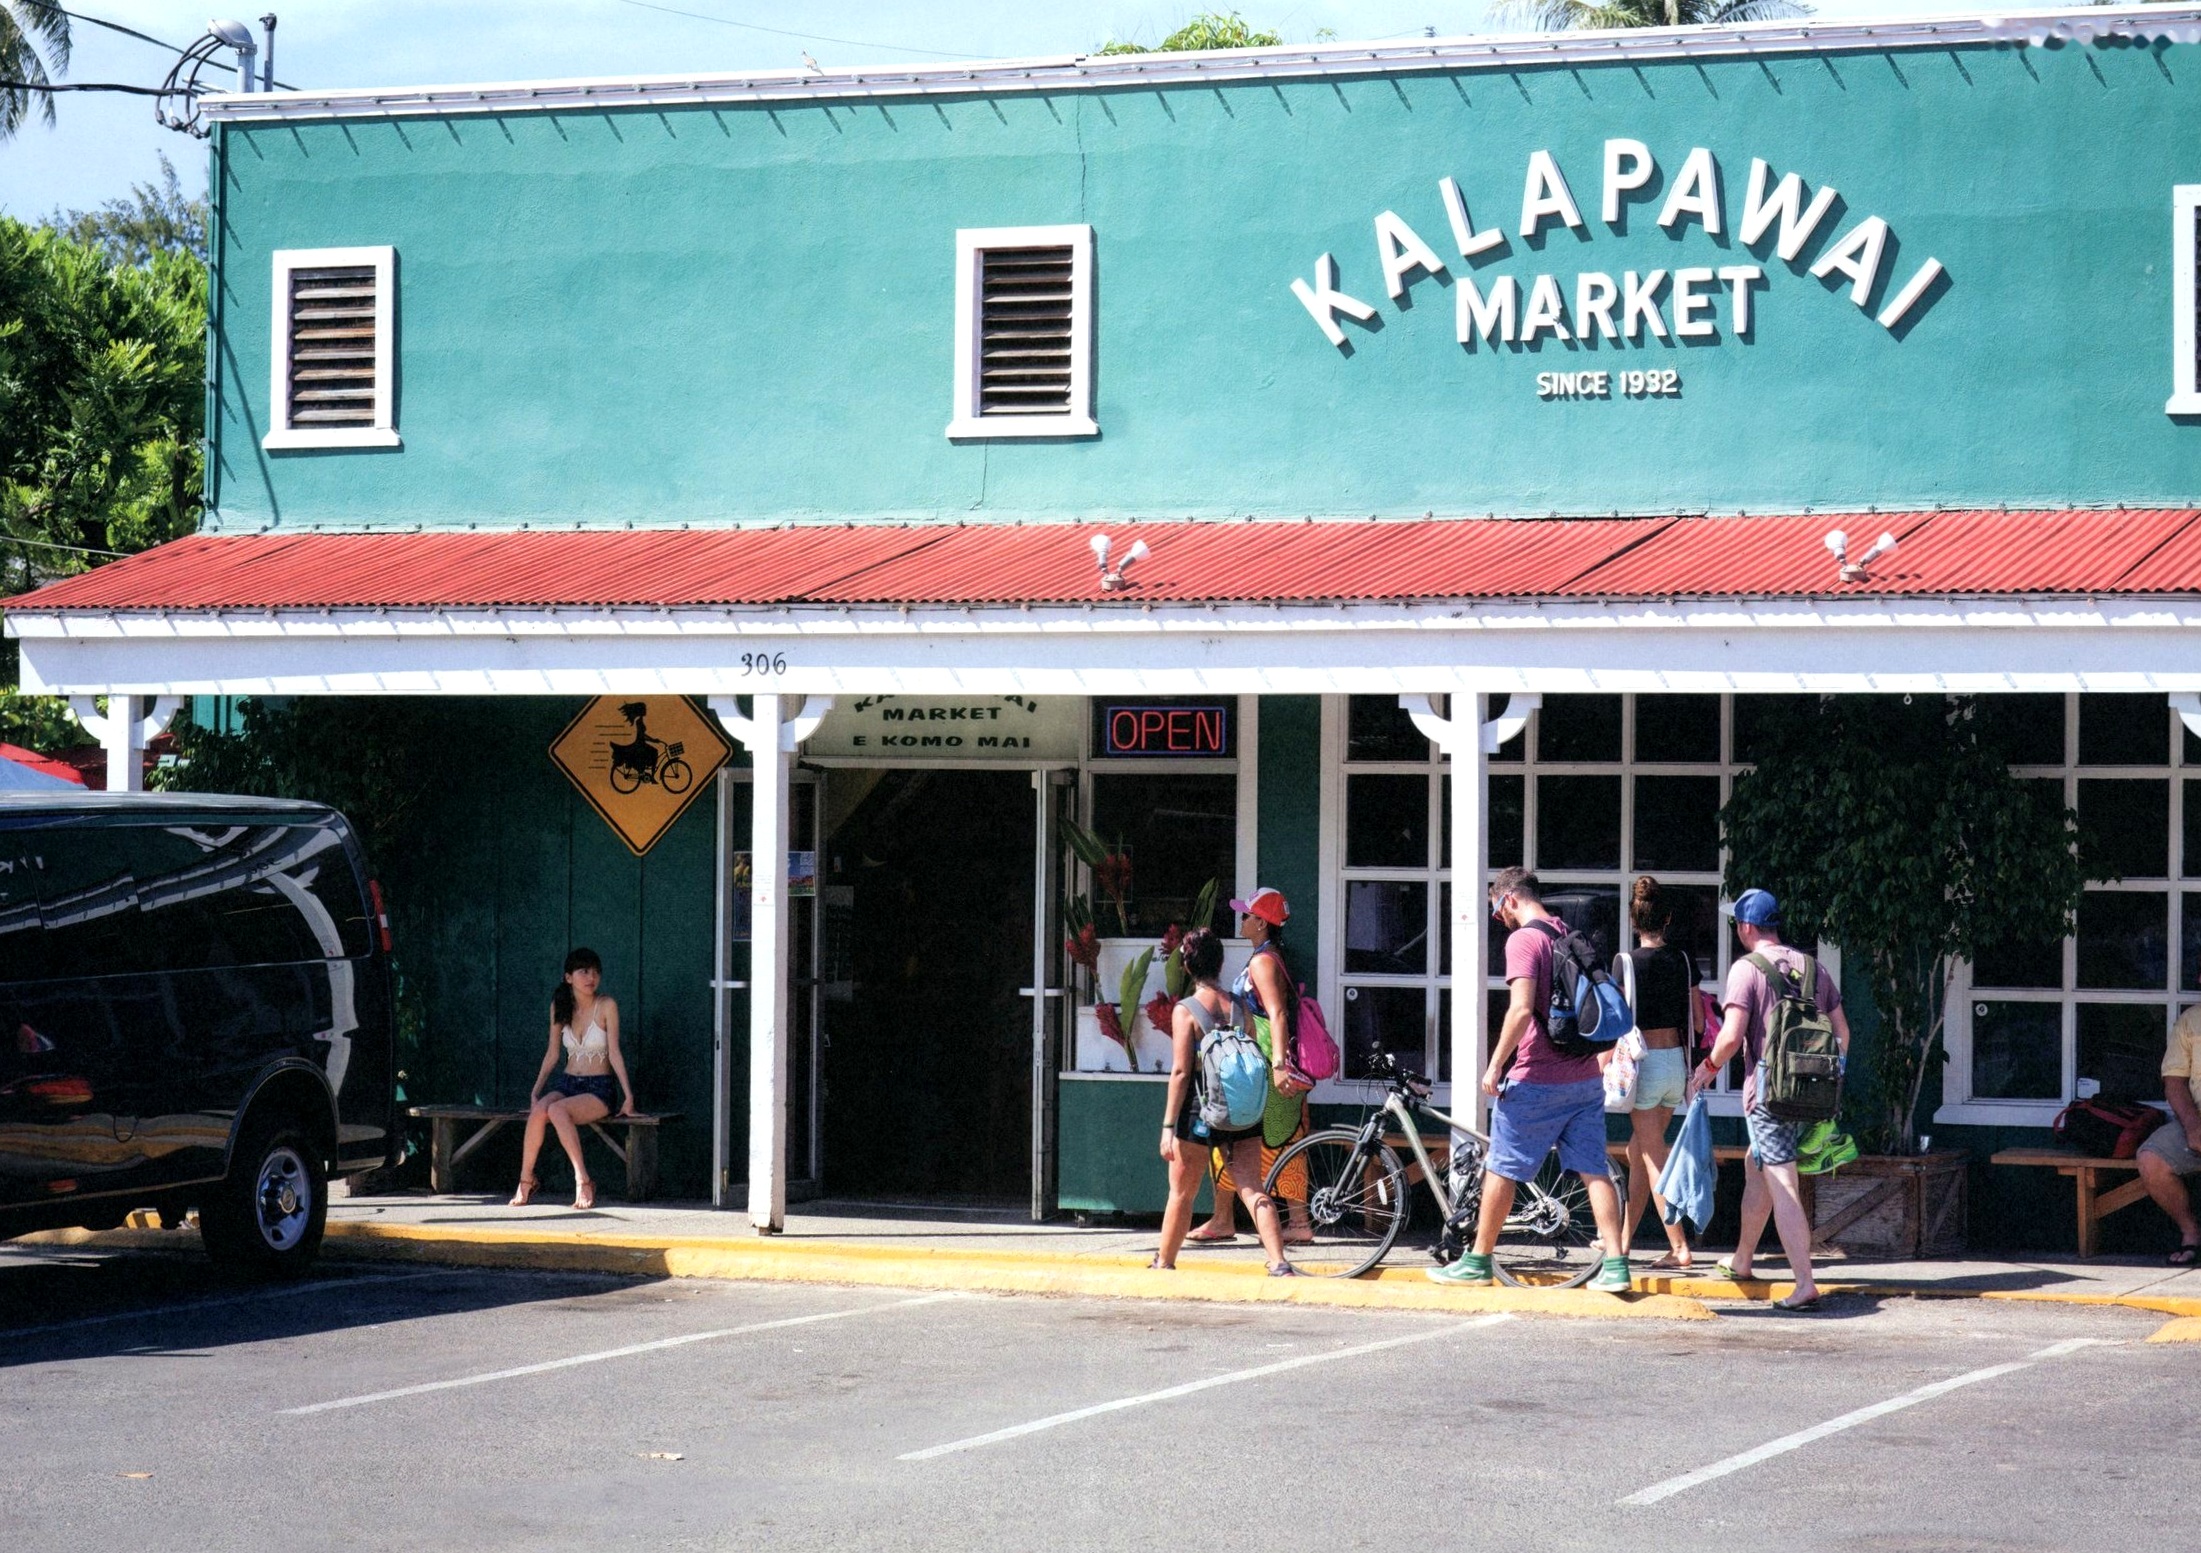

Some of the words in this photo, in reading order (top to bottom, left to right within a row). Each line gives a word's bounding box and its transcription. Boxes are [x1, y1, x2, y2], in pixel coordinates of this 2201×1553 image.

[1290, 138, 1943, 346] KALAPAWAI
[1455, 266, 1761, 342] MARKET
[1536, 371, 1608, 396] SINCE
[1619, 369, 1678, 394] 1932
[741, 652, 786, 677] 306
[883, 707, 1002, 721] MARKET
[853, 735, 867, 746] E
[882, 735, 963, 747] KOMO
[977, 736, 1031, 748] MAI
[1112, 711, 1220, 750] OPEN
